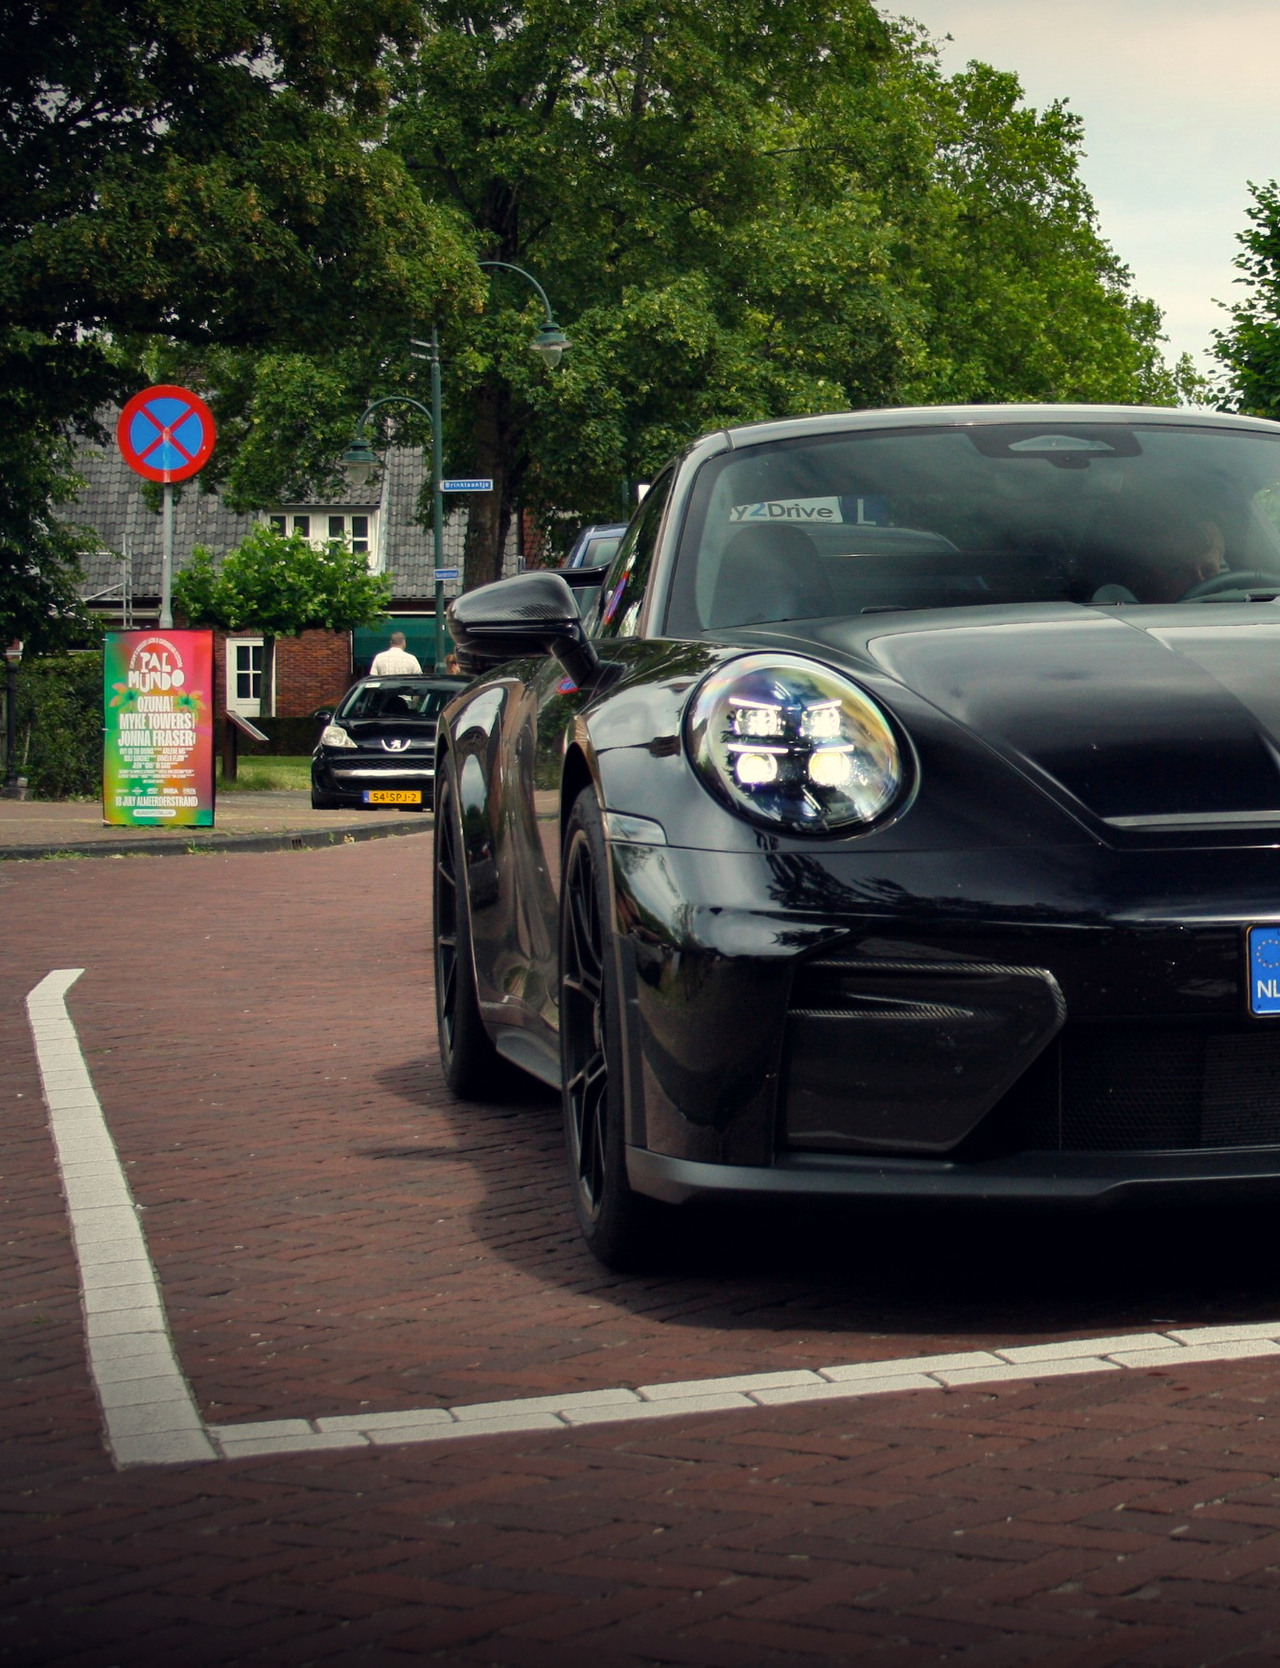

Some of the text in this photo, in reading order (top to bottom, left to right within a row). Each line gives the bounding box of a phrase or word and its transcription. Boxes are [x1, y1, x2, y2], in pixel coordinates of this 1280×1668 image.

[732, 502, 834, 520] y2Drive
[857, 498, 877, 526] L
[140, 652, 171, 673] PAL
[128, 669, 184, 693] MUNDO
[137, 695, 170, 712] OZUNA
[120, 713, 192, 729] MYKE TOWERS
[118, 730, 193, 746] JONNA FRASER
